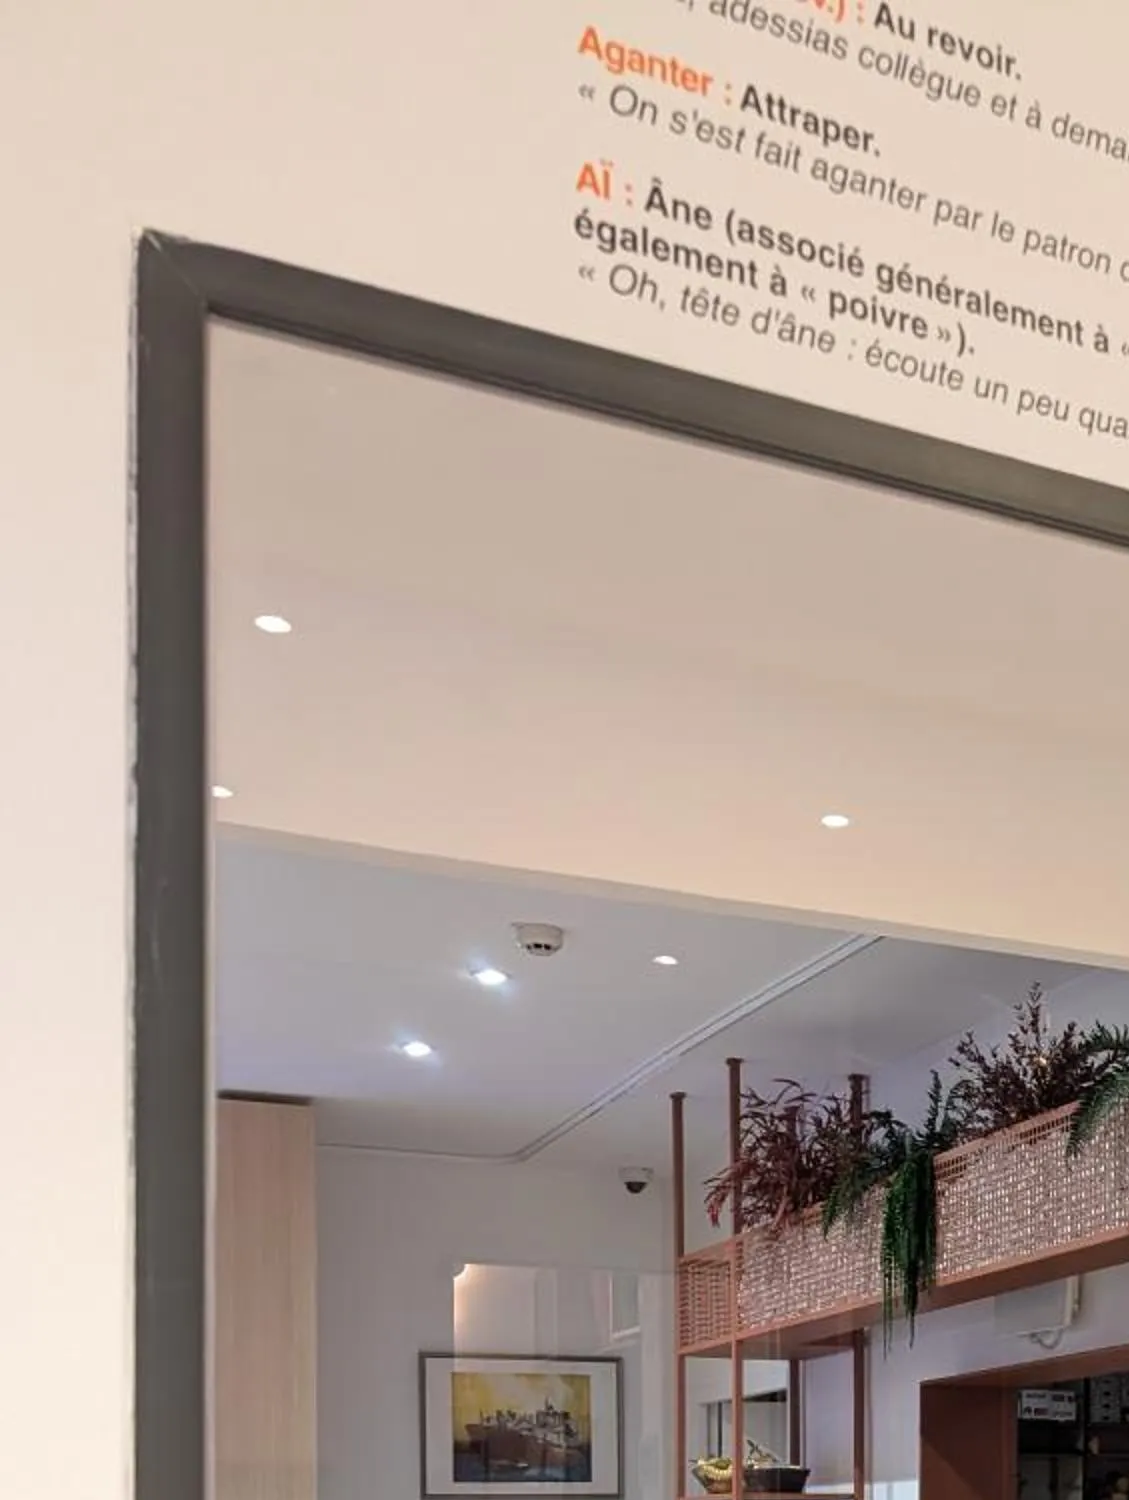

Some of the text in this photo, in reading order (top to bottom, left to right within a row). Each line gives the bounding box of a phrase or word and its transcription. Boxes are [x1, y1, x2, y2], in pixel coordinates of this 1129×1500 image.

[578, 27, 879, 156] Aganter Attraper.
[858, 45, 980, 107] collègue
[990, 94, 1017, 121] et
[873, 1, 1020, 80] Au revoir.
[609, 84, 658, 125] On
[669, 108, 745, 153] s'est
[755, 130, 801, 173] fait
[810, 157, 927, 212] aganter
[933, 198, 983, 231] par
[991, 210, 1014, 242] le
[1022, 228, 1110, 273] patron
[576, 160, 610, 199] AÏ
[644, 182, 712, 230] Âne
[725, 208, 864, 277] (associé
[876, 262, 1083, 346] généralement
